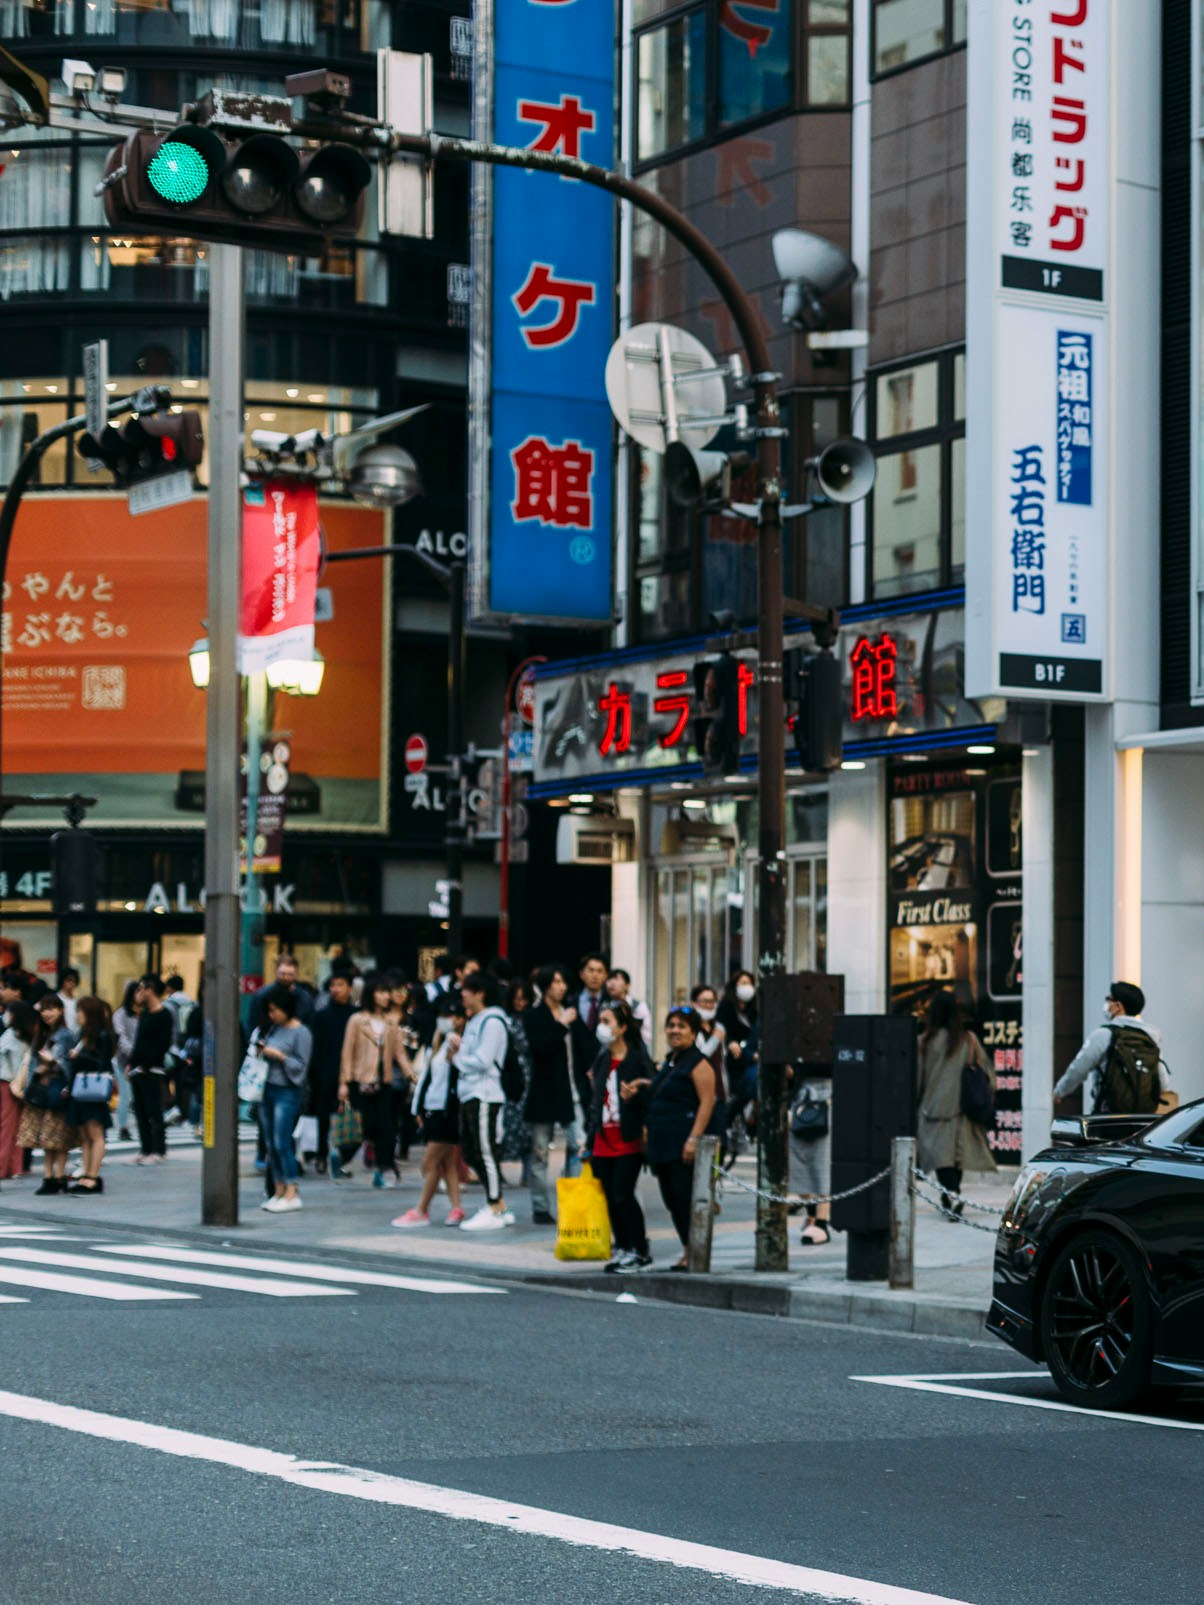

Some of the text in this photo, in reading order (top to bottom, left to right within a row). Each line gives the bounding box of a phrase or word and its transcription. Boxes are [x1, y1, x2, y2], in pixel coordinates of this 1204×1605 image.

[1012, 17, 1032, 101] STORE
[1042, 268, 1062, 288] 1F
[1059, 335, 1090, 402] 元祖
[1010, 444, 1046, 616] 五右衛門
[599, 632, 898, 758] カラ館
[1035, 663, 1065, 682] B1F
[896, 898, 971, 924] First Class
